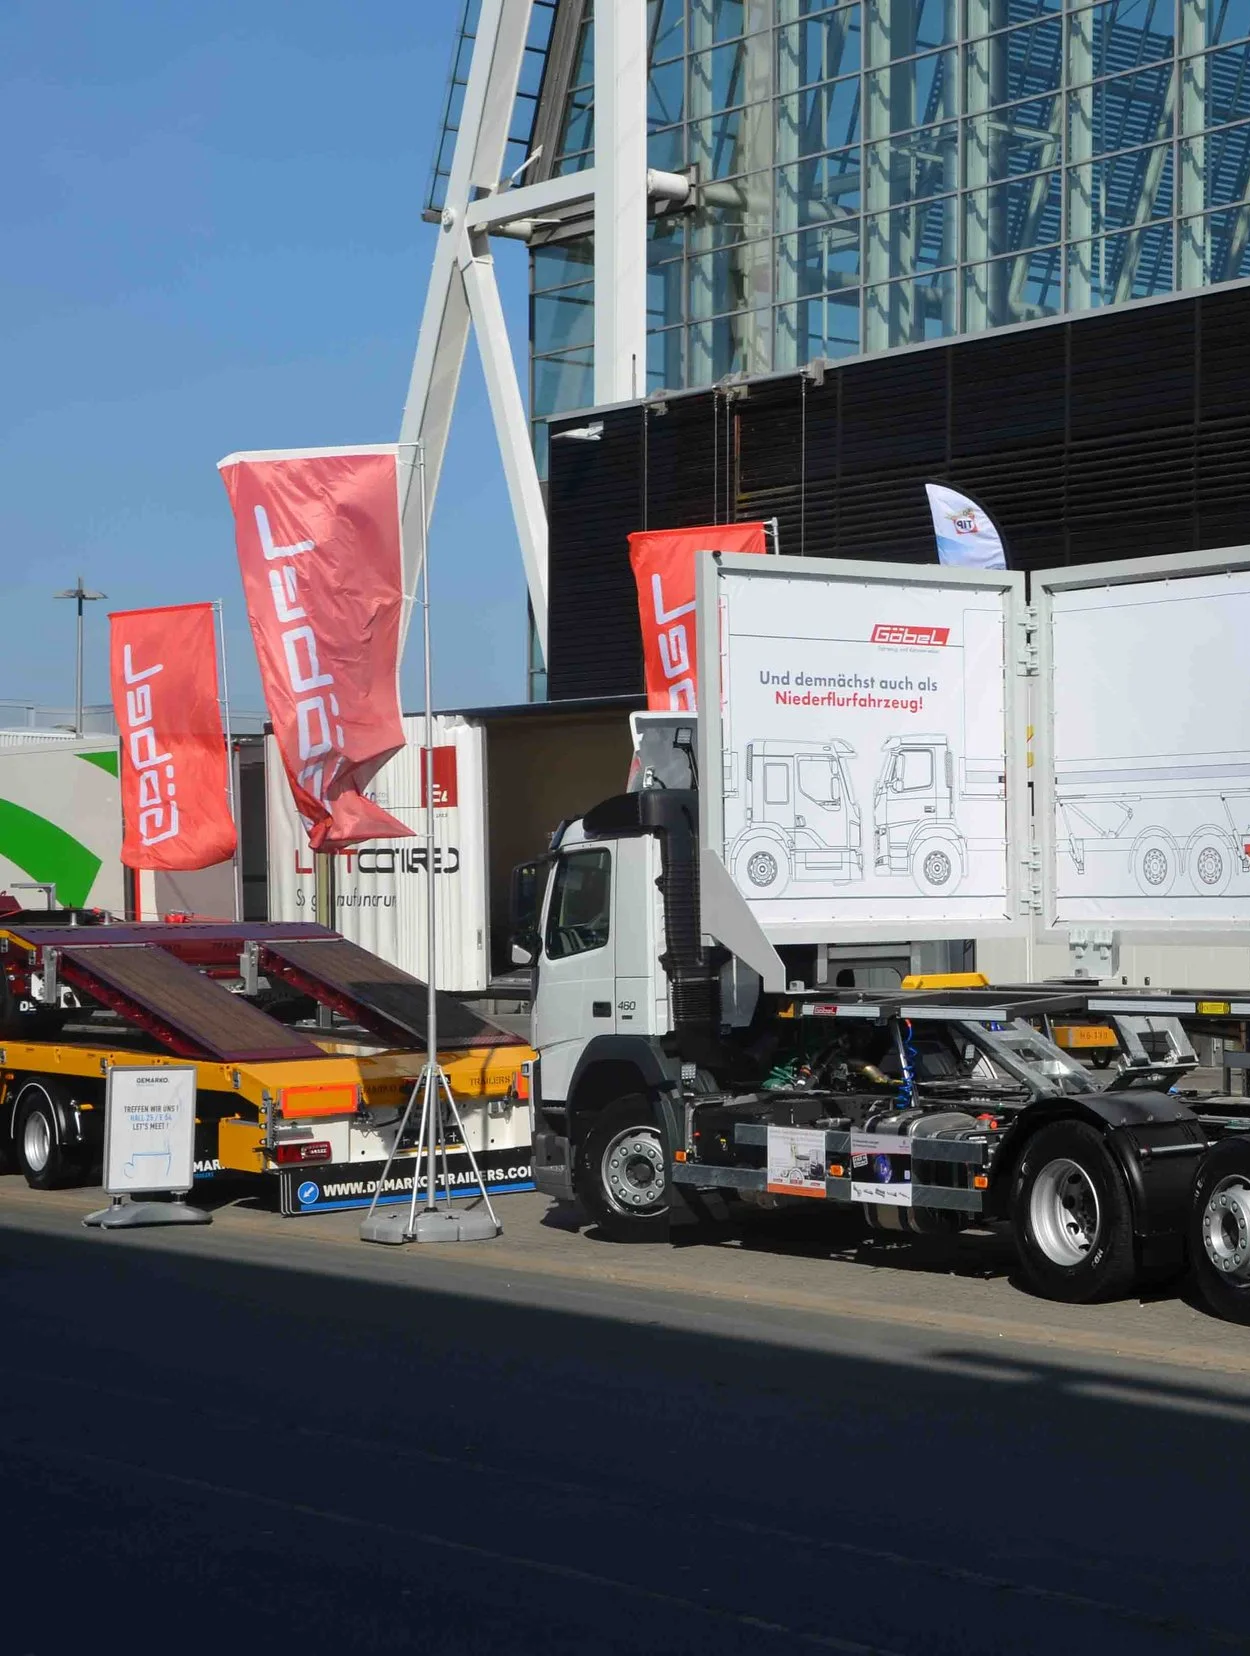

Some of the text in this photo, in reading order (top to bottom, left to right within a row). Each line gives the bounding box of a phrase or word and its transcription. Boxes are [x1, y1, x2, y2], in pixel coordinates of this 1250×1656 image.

[759, 671, 938, 692] Und demnächst auch als
[775, 691, 923, 713] Niederflurfahrzeug!
[617, 1001, 636, 1010] 460
[124, 1105, 149, 1113] TREFFEN
[150, 1105, 162, 1113] WIR
[163, 1104, 175, 1113] UNS
